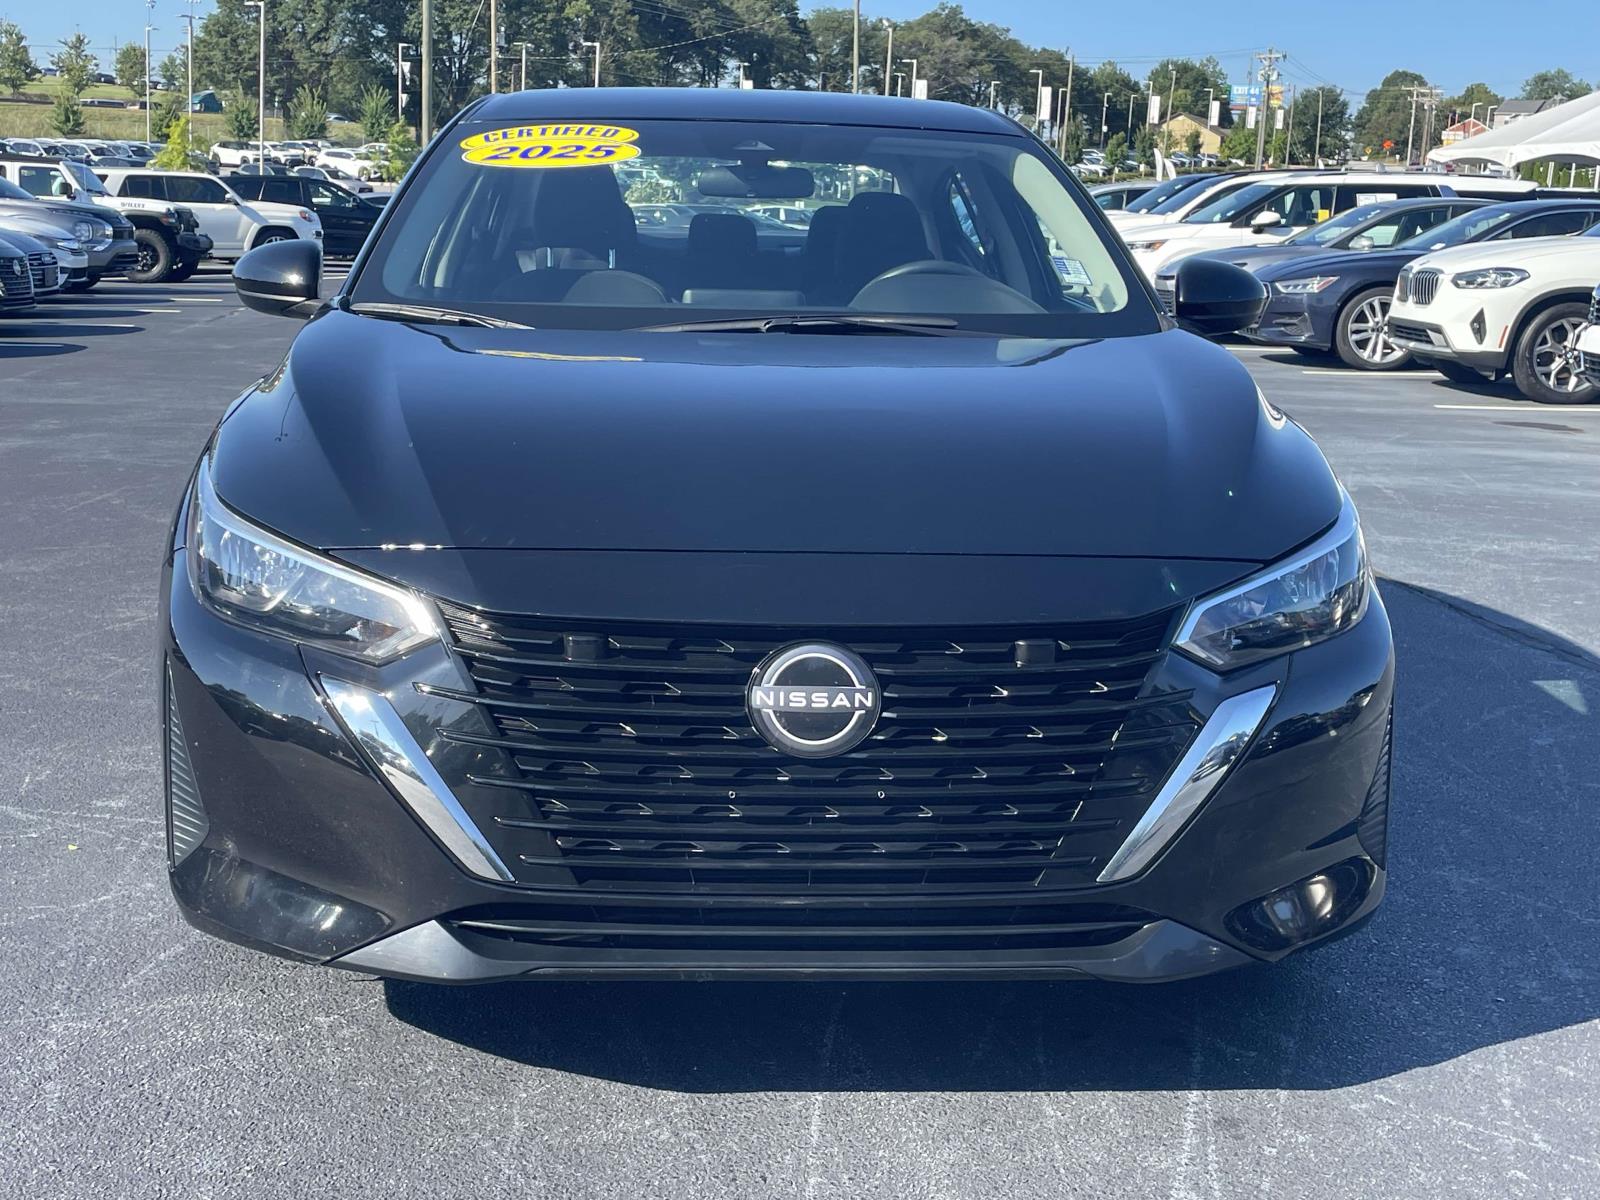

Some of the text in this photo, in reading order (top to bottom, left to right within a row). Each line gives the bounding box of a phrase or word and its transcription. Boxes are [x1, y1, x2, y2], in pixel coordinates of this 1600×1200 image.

[484, 126, 621, 143] CERTIFIED
[482, 145, 619, 160] 2025
[756, 690, 872, 708] NISSAN
